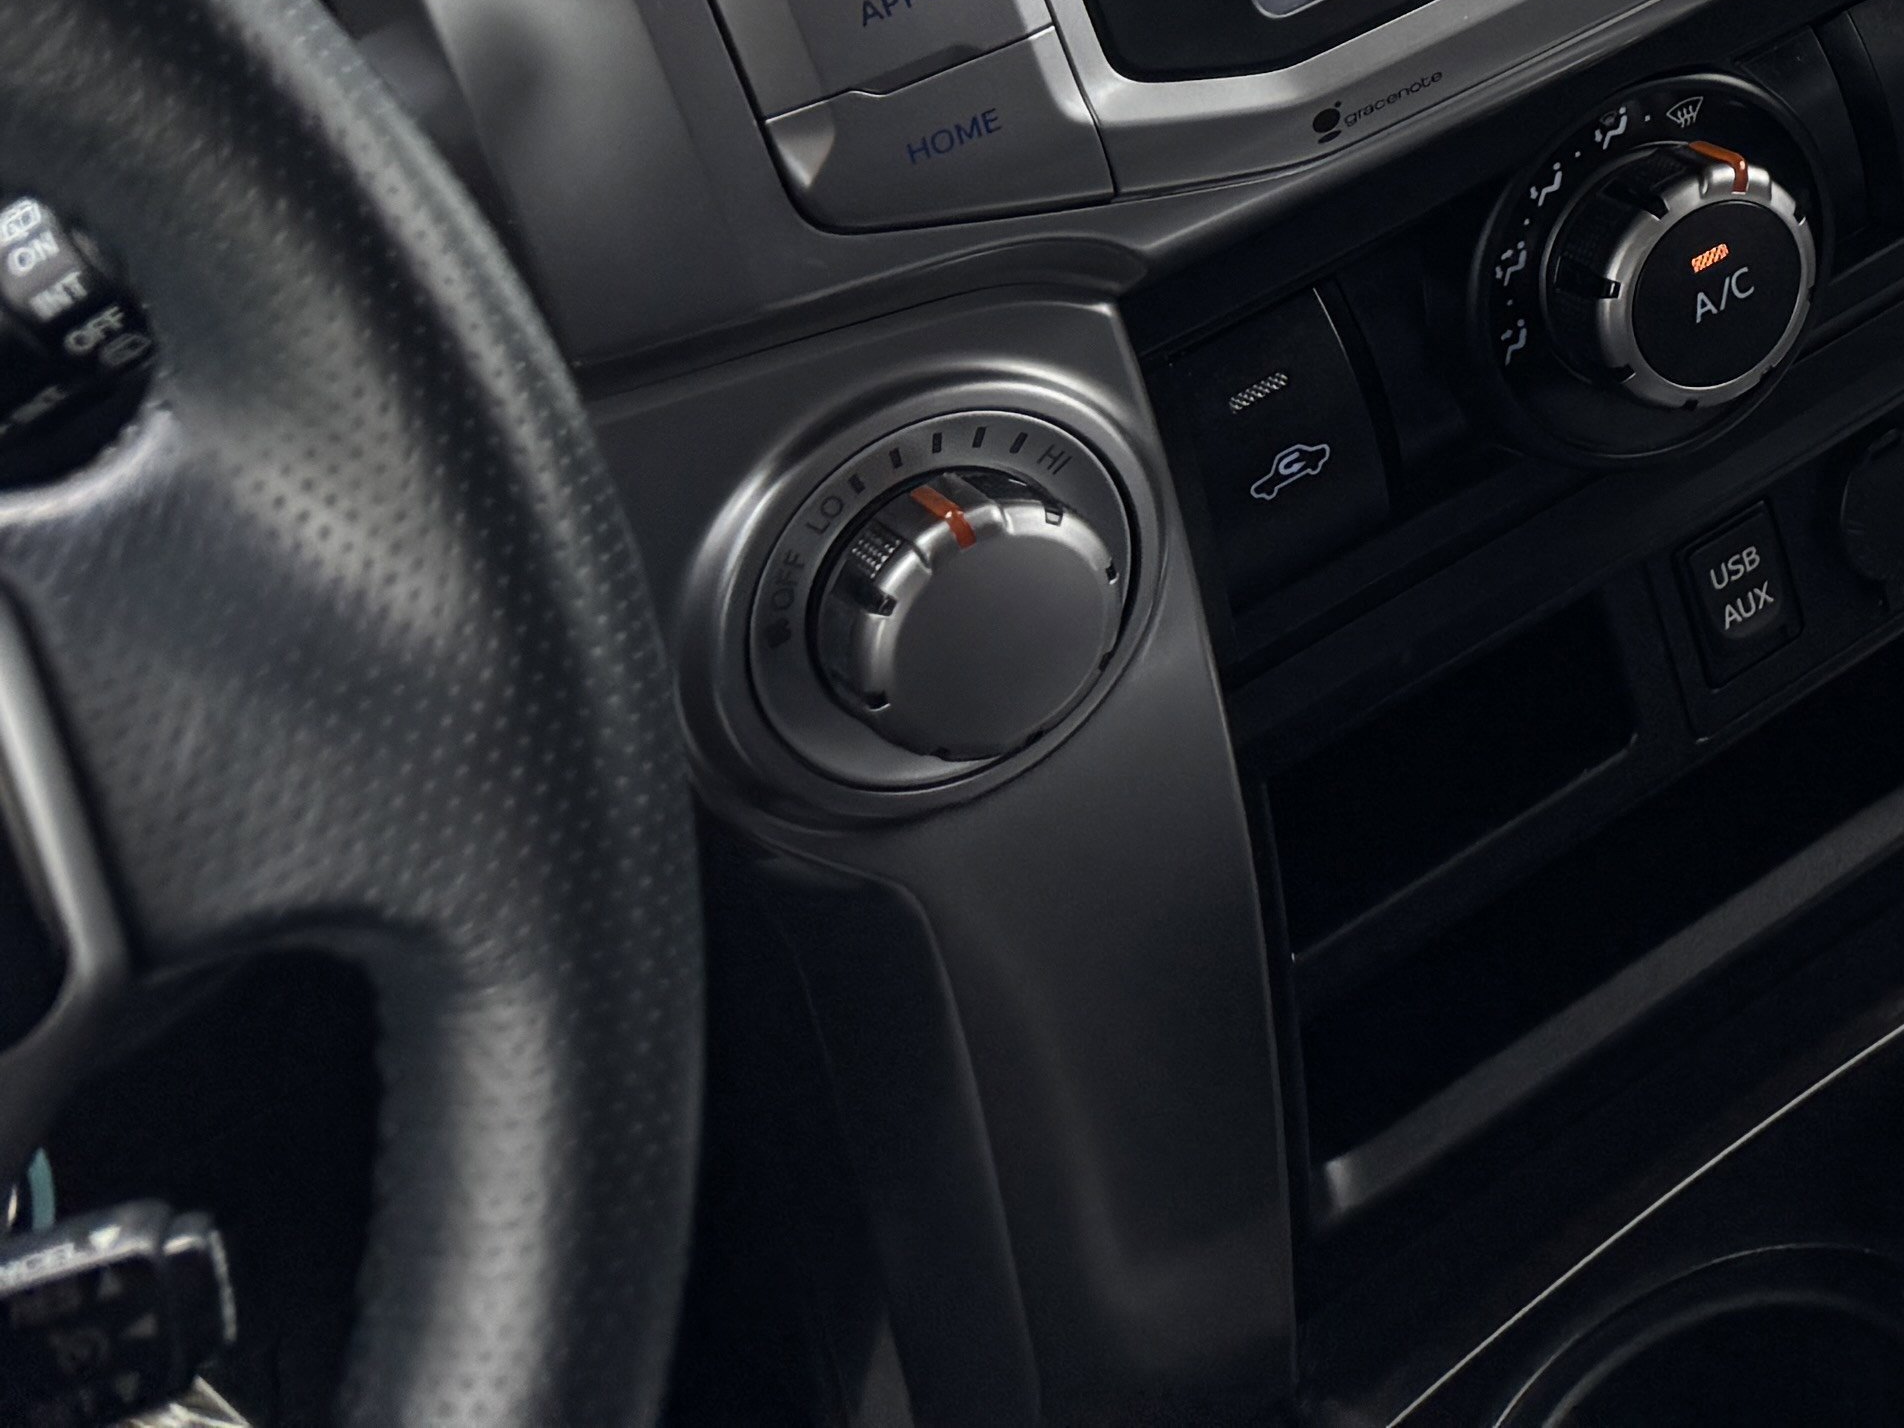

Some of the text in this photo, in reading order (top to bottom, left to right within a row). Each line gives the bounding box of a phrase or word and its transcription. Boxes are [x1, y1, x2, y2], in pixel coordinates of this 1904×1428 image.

[1344, 71, 1443, 127] gracenote
[905, 107, 1003, 167] HOME
[7, 229, 61, 278] ON
[1694, 266, 1755, 324] A/C
[63, 305, 126, 356] OFF
[1036, 444, 1073, 476] HI
[803, 495, 845, 536] LO
[772, 548, 805, 612] OFF
[1709, 545, 1761, 590] USB
[1724, 580, 1775, 631] AUX
